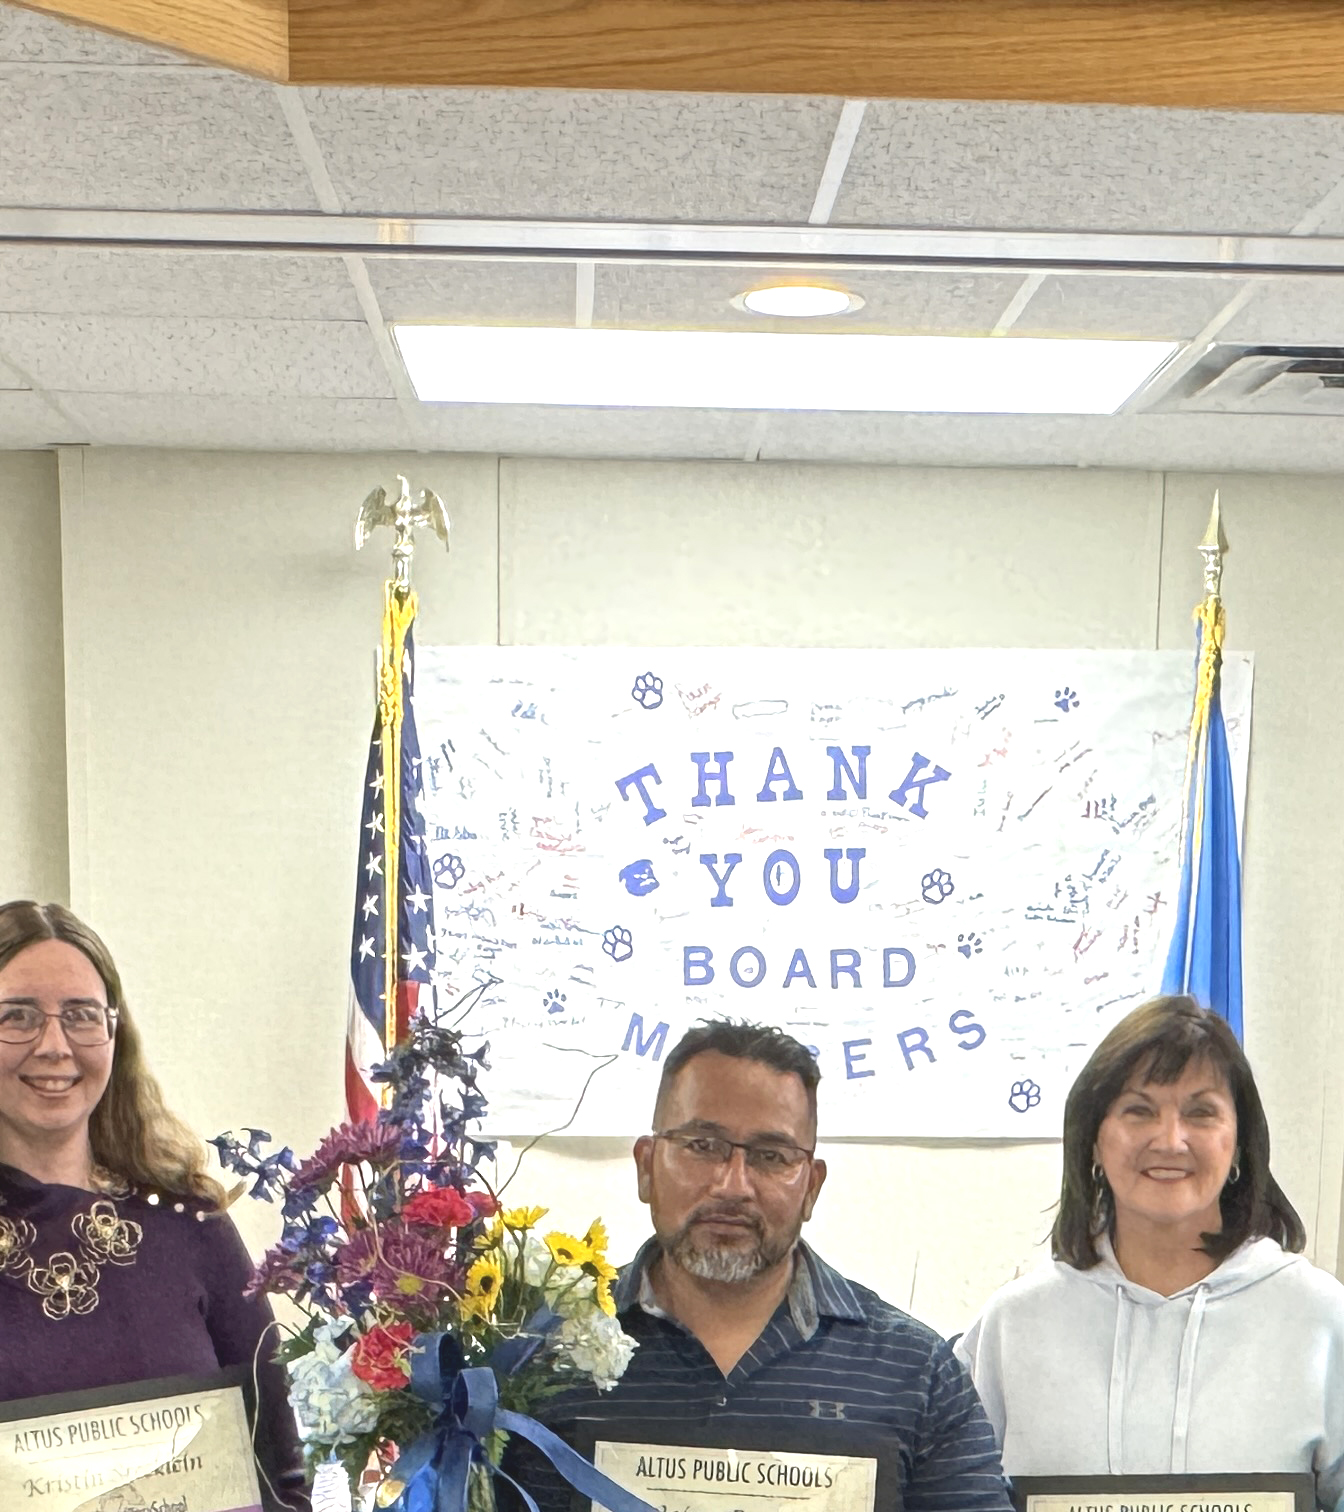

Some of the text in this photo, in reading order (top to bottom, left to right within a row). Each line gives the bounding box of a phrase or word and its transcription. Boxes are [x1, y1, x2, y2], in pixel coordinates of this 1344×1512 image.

[614, 744, 952, 827] THANK
[699, 848, 867, 908] YOU
[682, 944, 918, 989] BOARD
[621, 1008, 987, 1081] MERS
[14, 1404, 205, 1455] ALTUS PUBLIC SCHOOLS
[635, 1456, 834, 1489] ALTUS PUBLIC SCHOOLS
